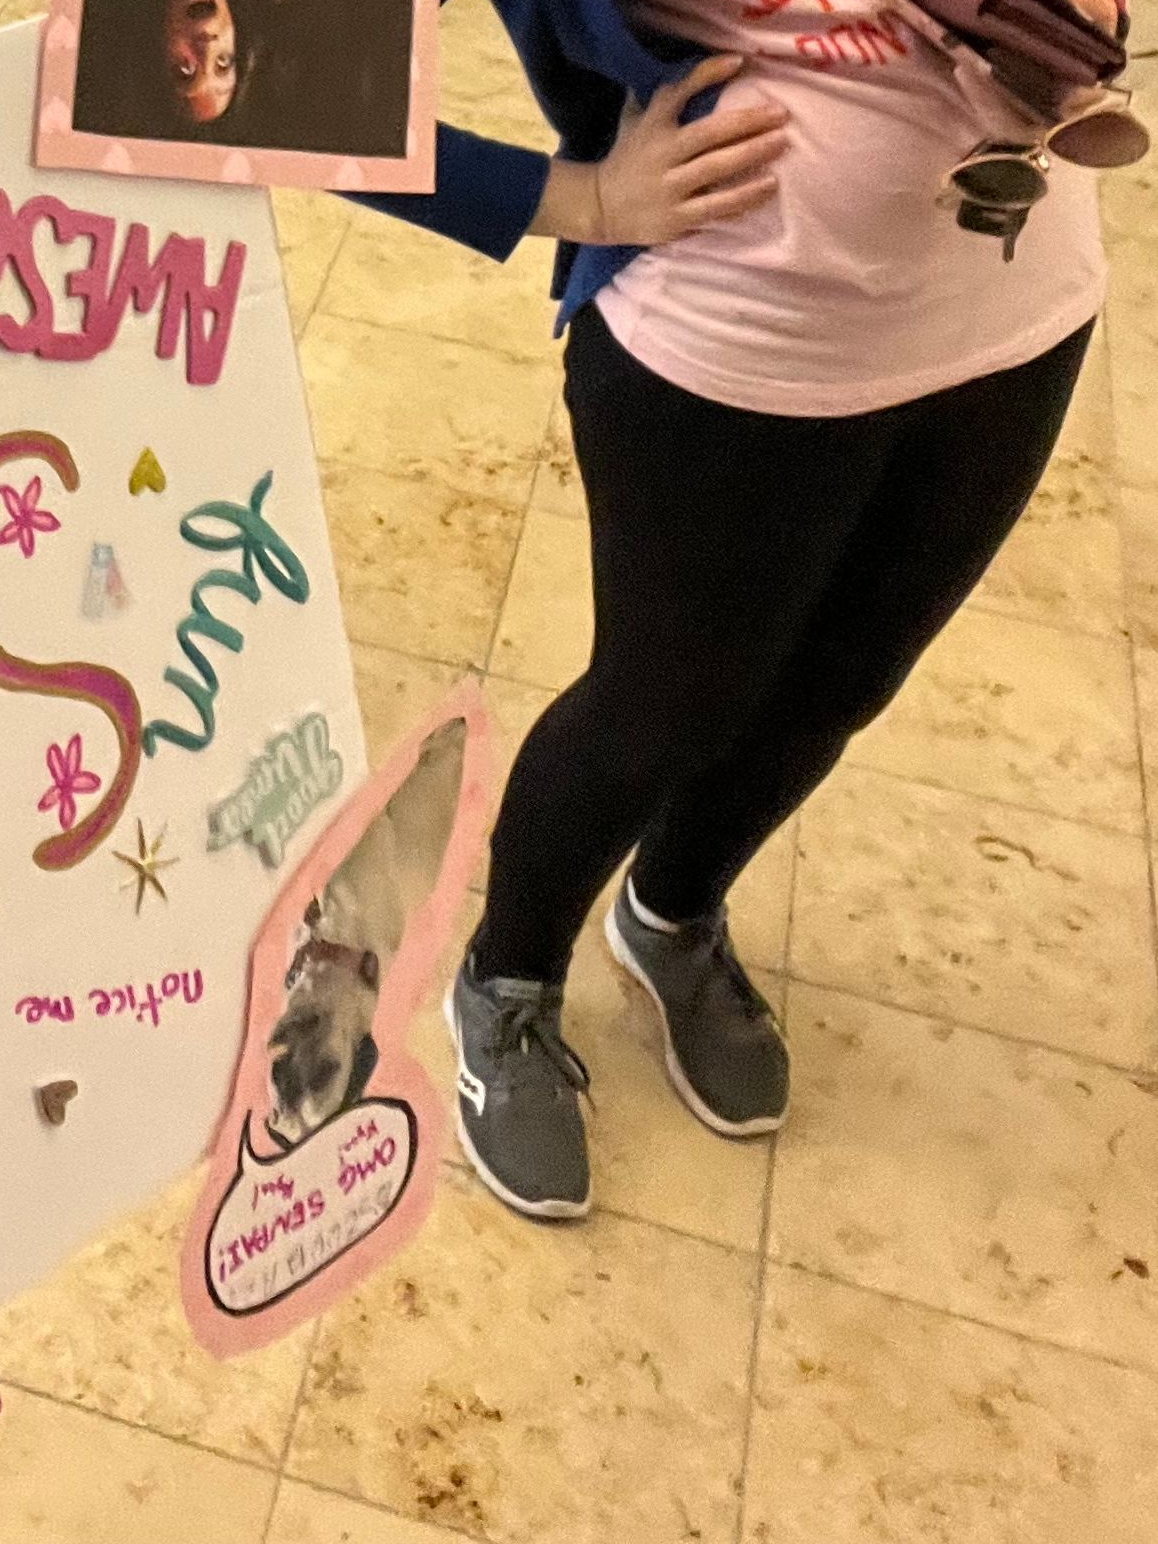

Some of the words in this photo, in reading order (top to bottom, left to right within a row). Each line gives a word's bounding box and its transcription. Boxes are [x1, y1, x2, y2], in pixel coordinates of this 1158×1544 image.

[141, 469, 311, 759] fun
[14, 995, 75, 1024] me
[88, 968, 204, 1028] notice
[337, 1137, 396, 1196] OMG
[219, 1189, 325, 1283] SENPAI!
